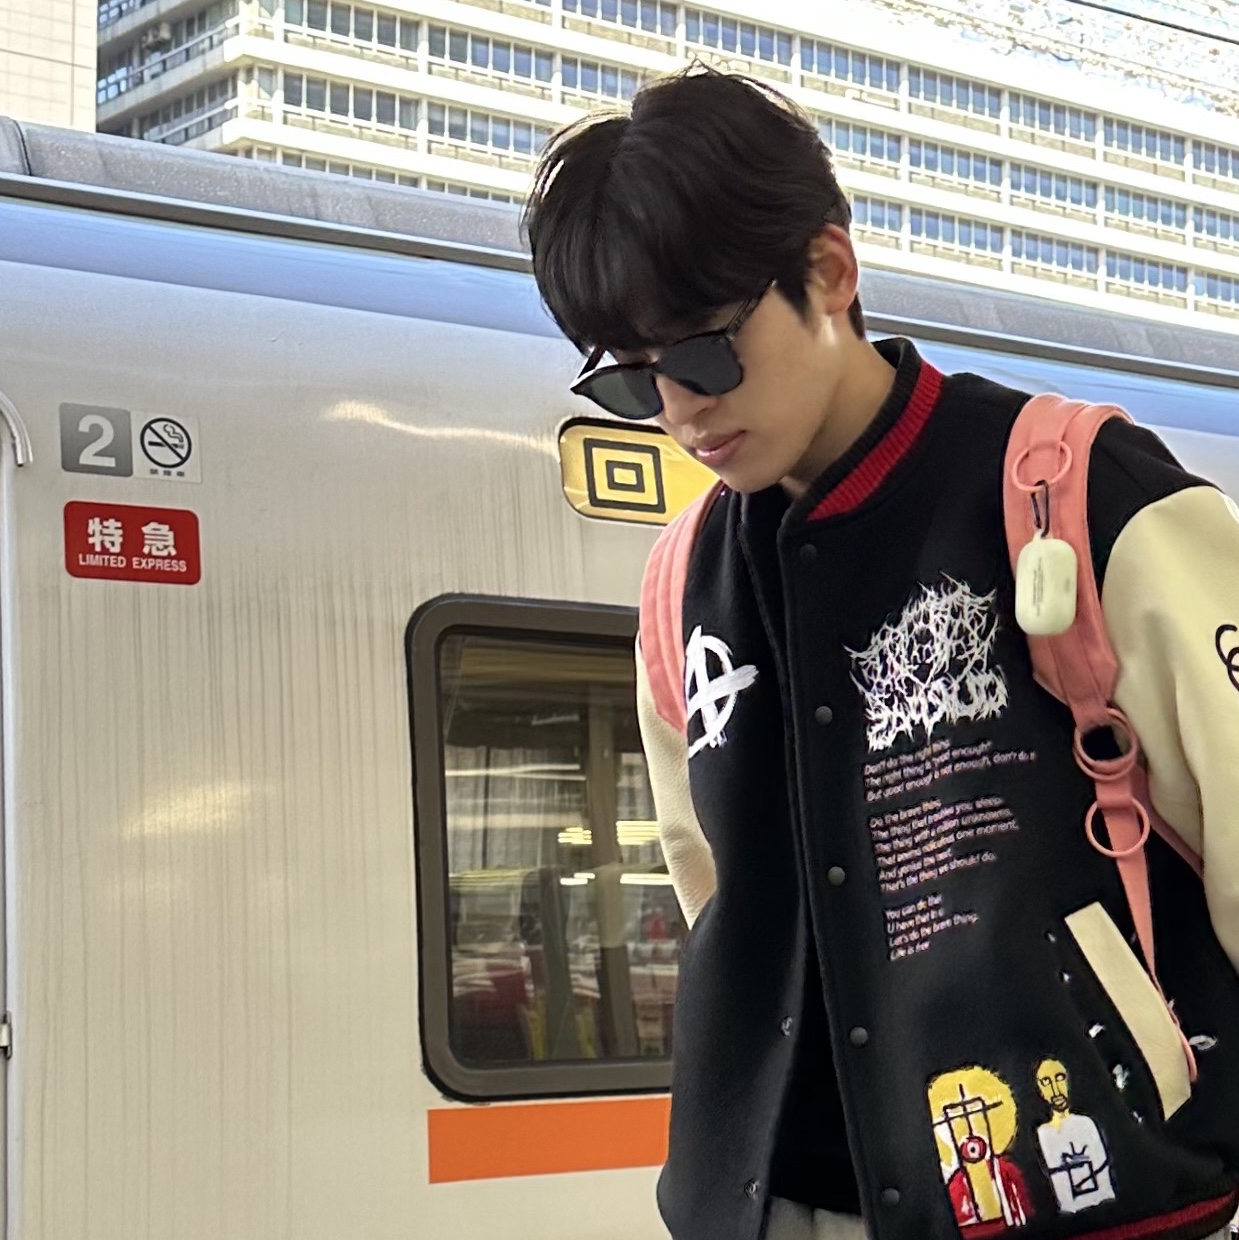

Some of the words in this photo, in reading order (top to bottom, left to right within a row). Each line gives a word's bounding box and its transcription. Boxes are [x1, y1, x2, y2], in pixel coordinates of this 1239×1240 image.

[78, 414, 116, 468] 2
[87, 516, 177, 557] 特急
[78, 554, 127, 568] LIMITED
[132, 557, 187, 572] EXPRESS
